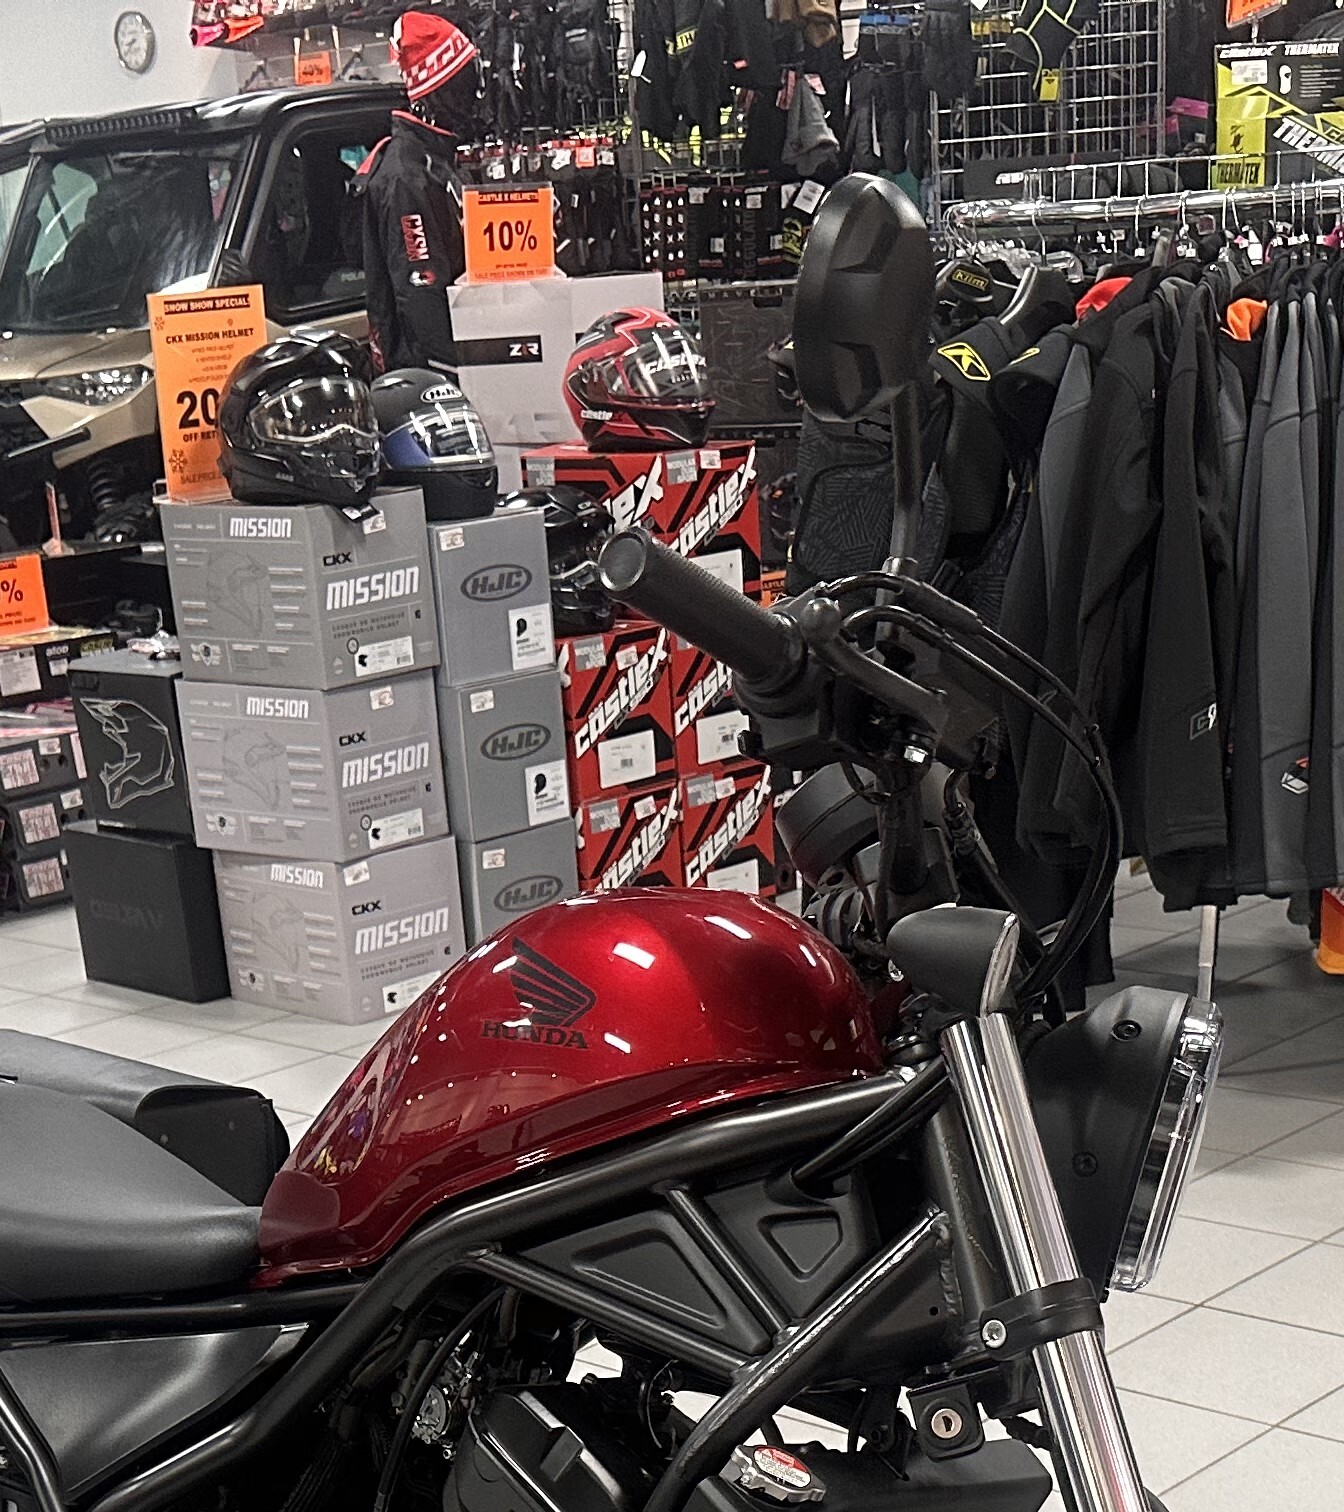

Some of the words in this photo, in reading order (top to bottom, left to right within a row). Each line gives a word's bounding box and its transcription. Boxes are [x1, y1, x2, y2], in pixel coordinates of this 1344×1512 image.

[1284, 43, 1340, 56] THERMATEK
[483, 219, 538, 252] 10%
[165, 303, 188, 313] SNOW
[190, 301, 213, 311] SHOW
[166, 335, 183, 344] CKX
[185, 332, 220, 342] MISSION
[222, 328, 254, 339] HELMET
[183, 432, 198, 443] OFF
[667, 446, 757, 558] astleX
[229, 517, 292, 539] MISSION
[323, 551, 352, 567] CKX
[326, 566, 420, 611] MISSION
[471, 570, 523, 595] HJC
[246, 696, 309, 719] MISSION
[339, 731, 366, 747] CKX
[490, 729, 542, 756] HJC
[342, 742, 430, 789] MISSION
[270, 863, 324, 889] MISSION
[503, 881, 555, 907] HJC
[351, 900, 383, 916] CKX
[355, 907, 449, 956] MISSION
[480, 1020, 589, 1050] HONDA
